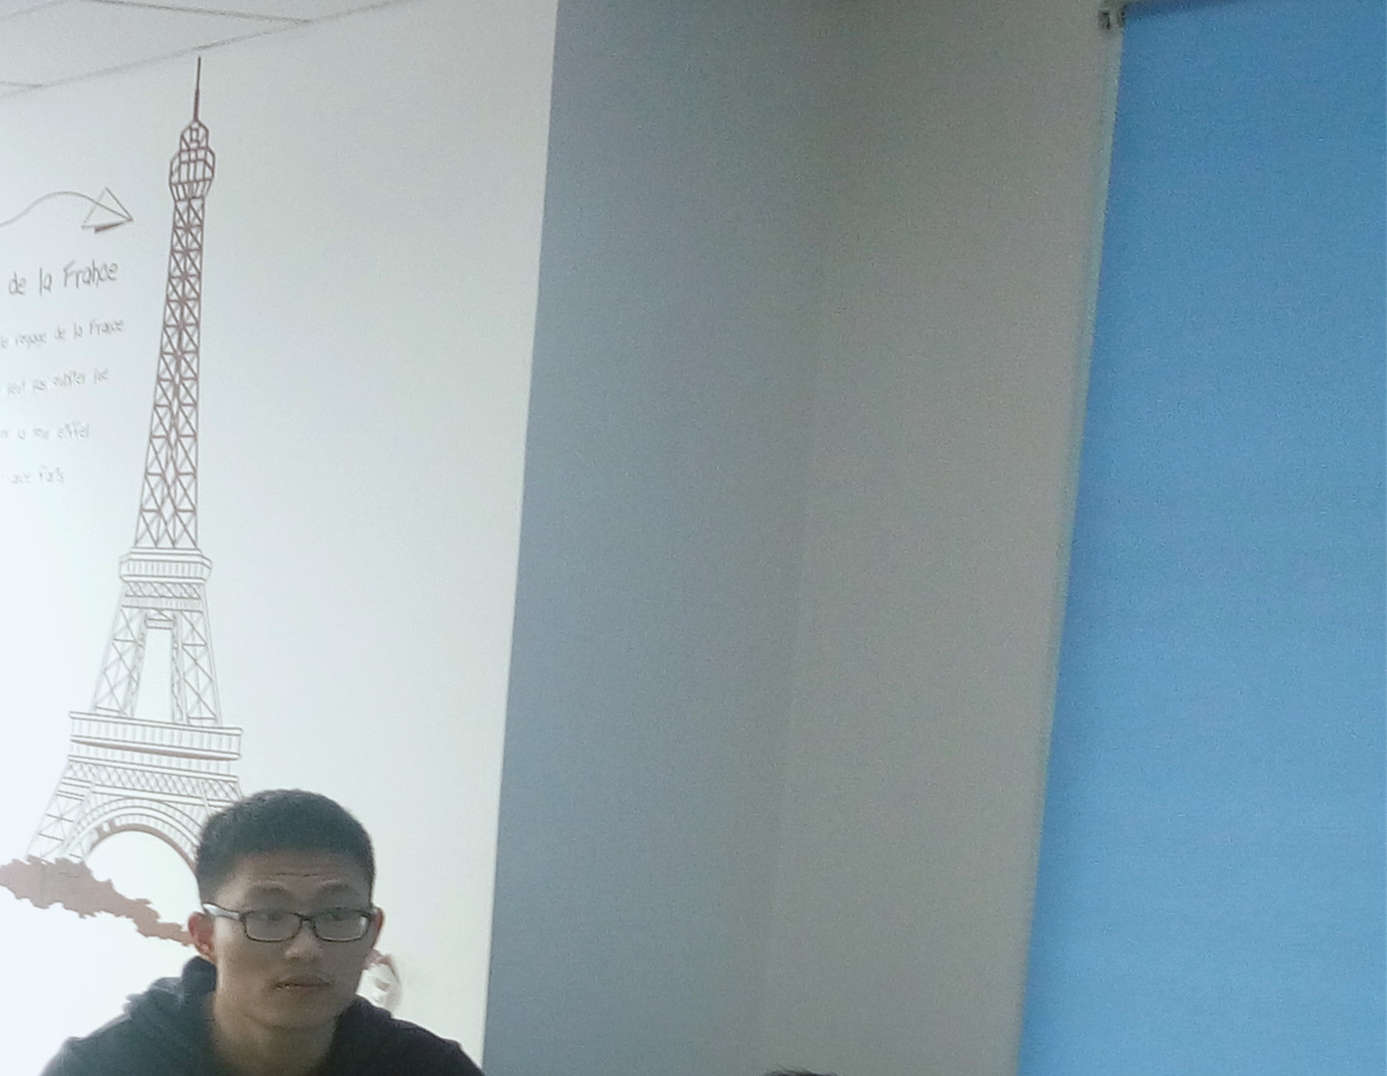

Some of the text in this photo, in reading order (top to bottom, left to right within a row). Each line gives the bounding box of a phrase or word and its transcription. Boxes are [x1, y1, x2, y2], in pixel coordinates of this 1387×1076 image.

[8, 271, 28, 296] de
[39, 266, 53, 297] la
[62, 257, 120, 290] France
